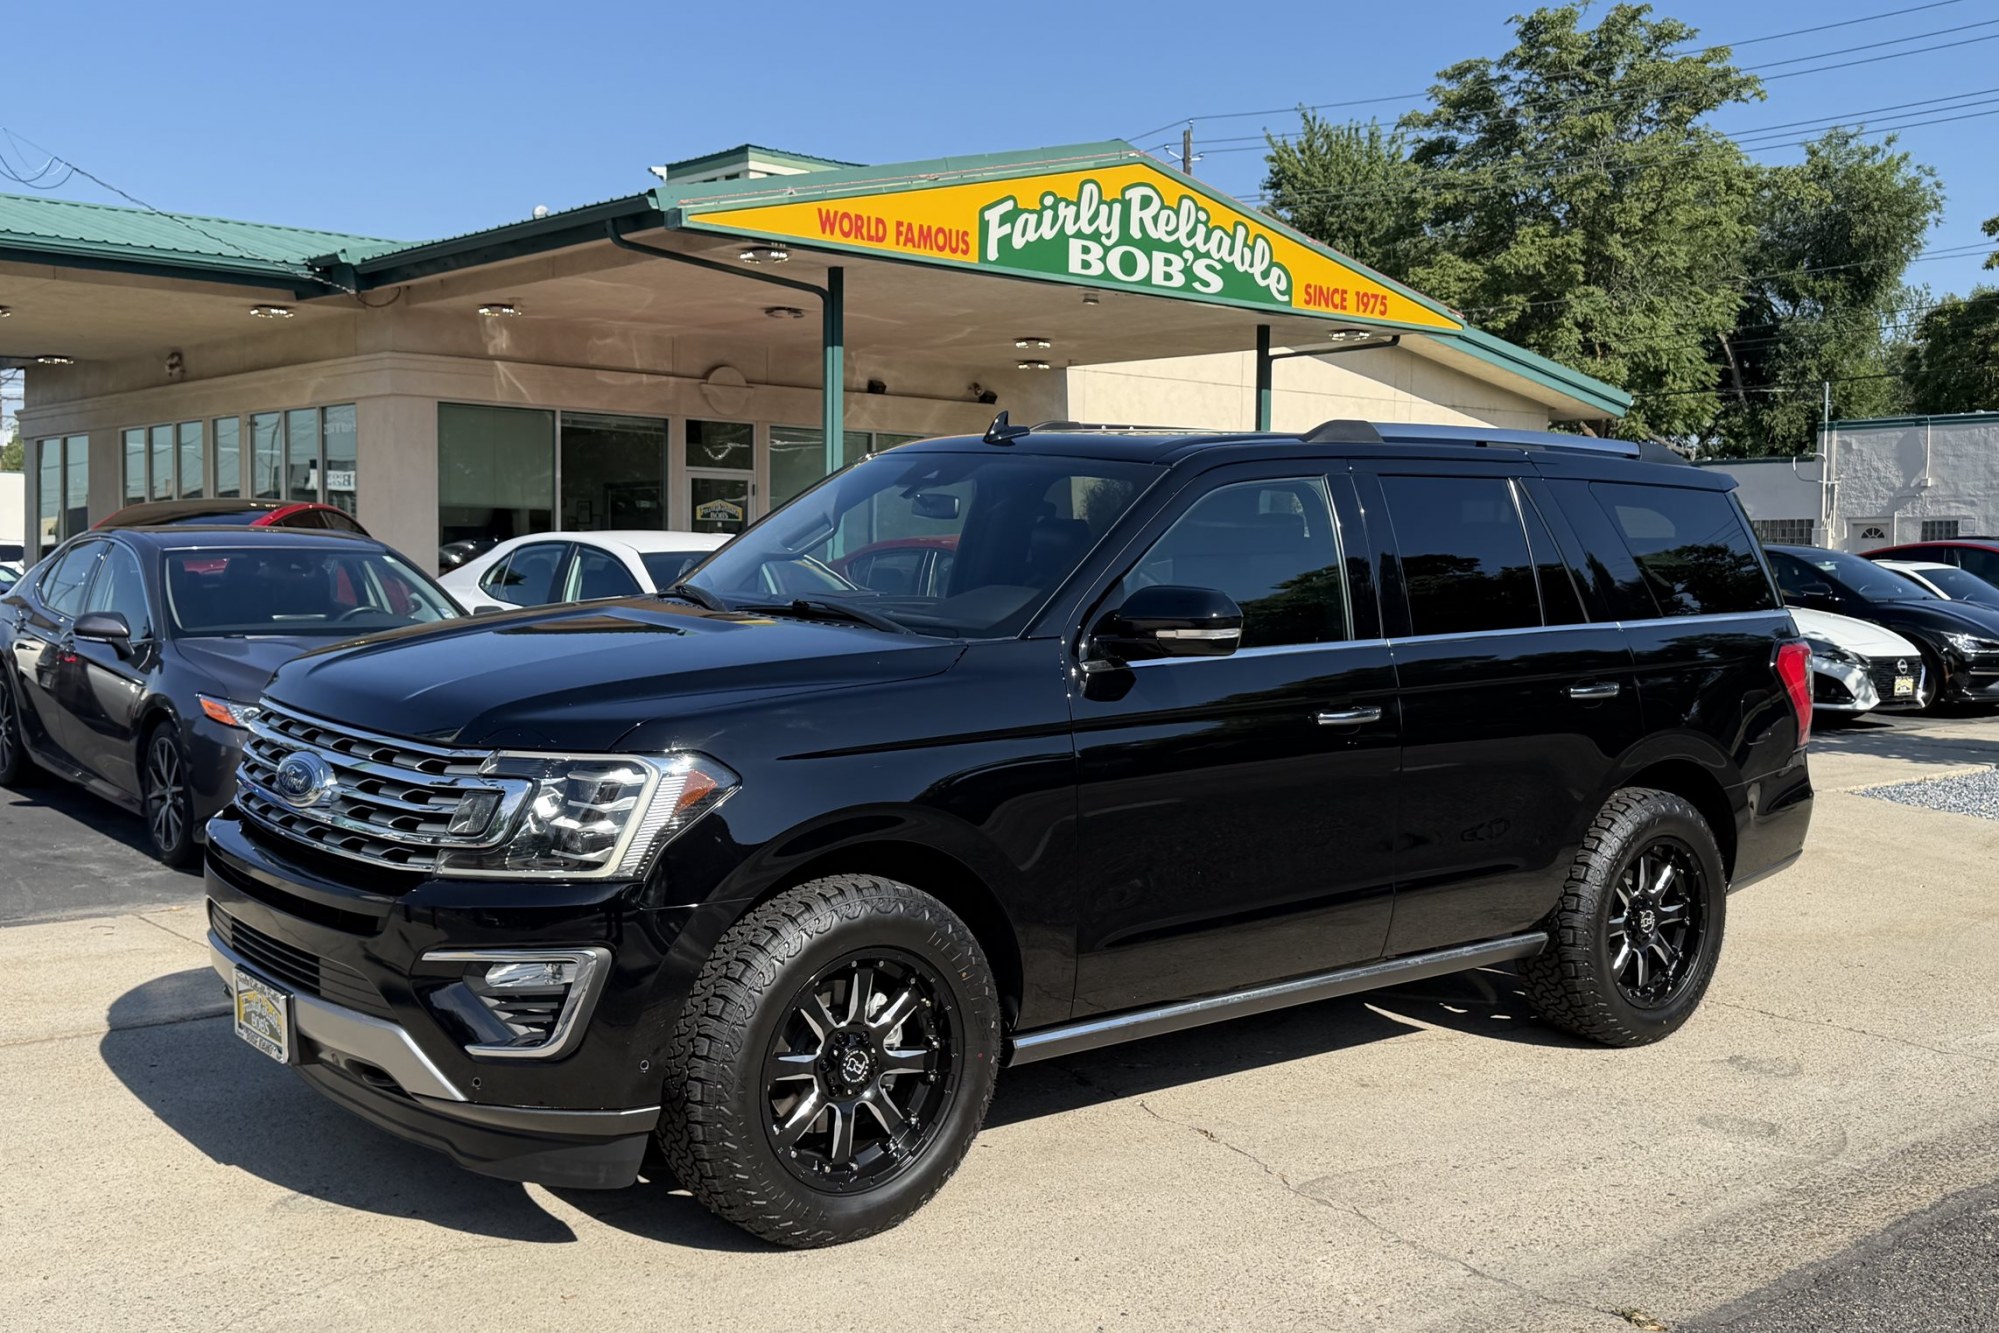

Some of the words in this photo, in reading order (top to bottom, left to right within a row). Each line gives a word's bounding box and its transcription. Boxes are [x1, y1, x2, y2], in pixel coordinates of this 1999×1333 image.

[817, 207, 887, 243] WORLD
[895, 220, 970, 256] FAMOUS
[984, 183, 1121, 261] Fairly
[1124, 186, 1290, 302] Reliable
[1068, 238, 1224, 294] BOB'S
[1304, 283, 1347, 310] SINCE
[1355, 291, 1387, 316] 1975
